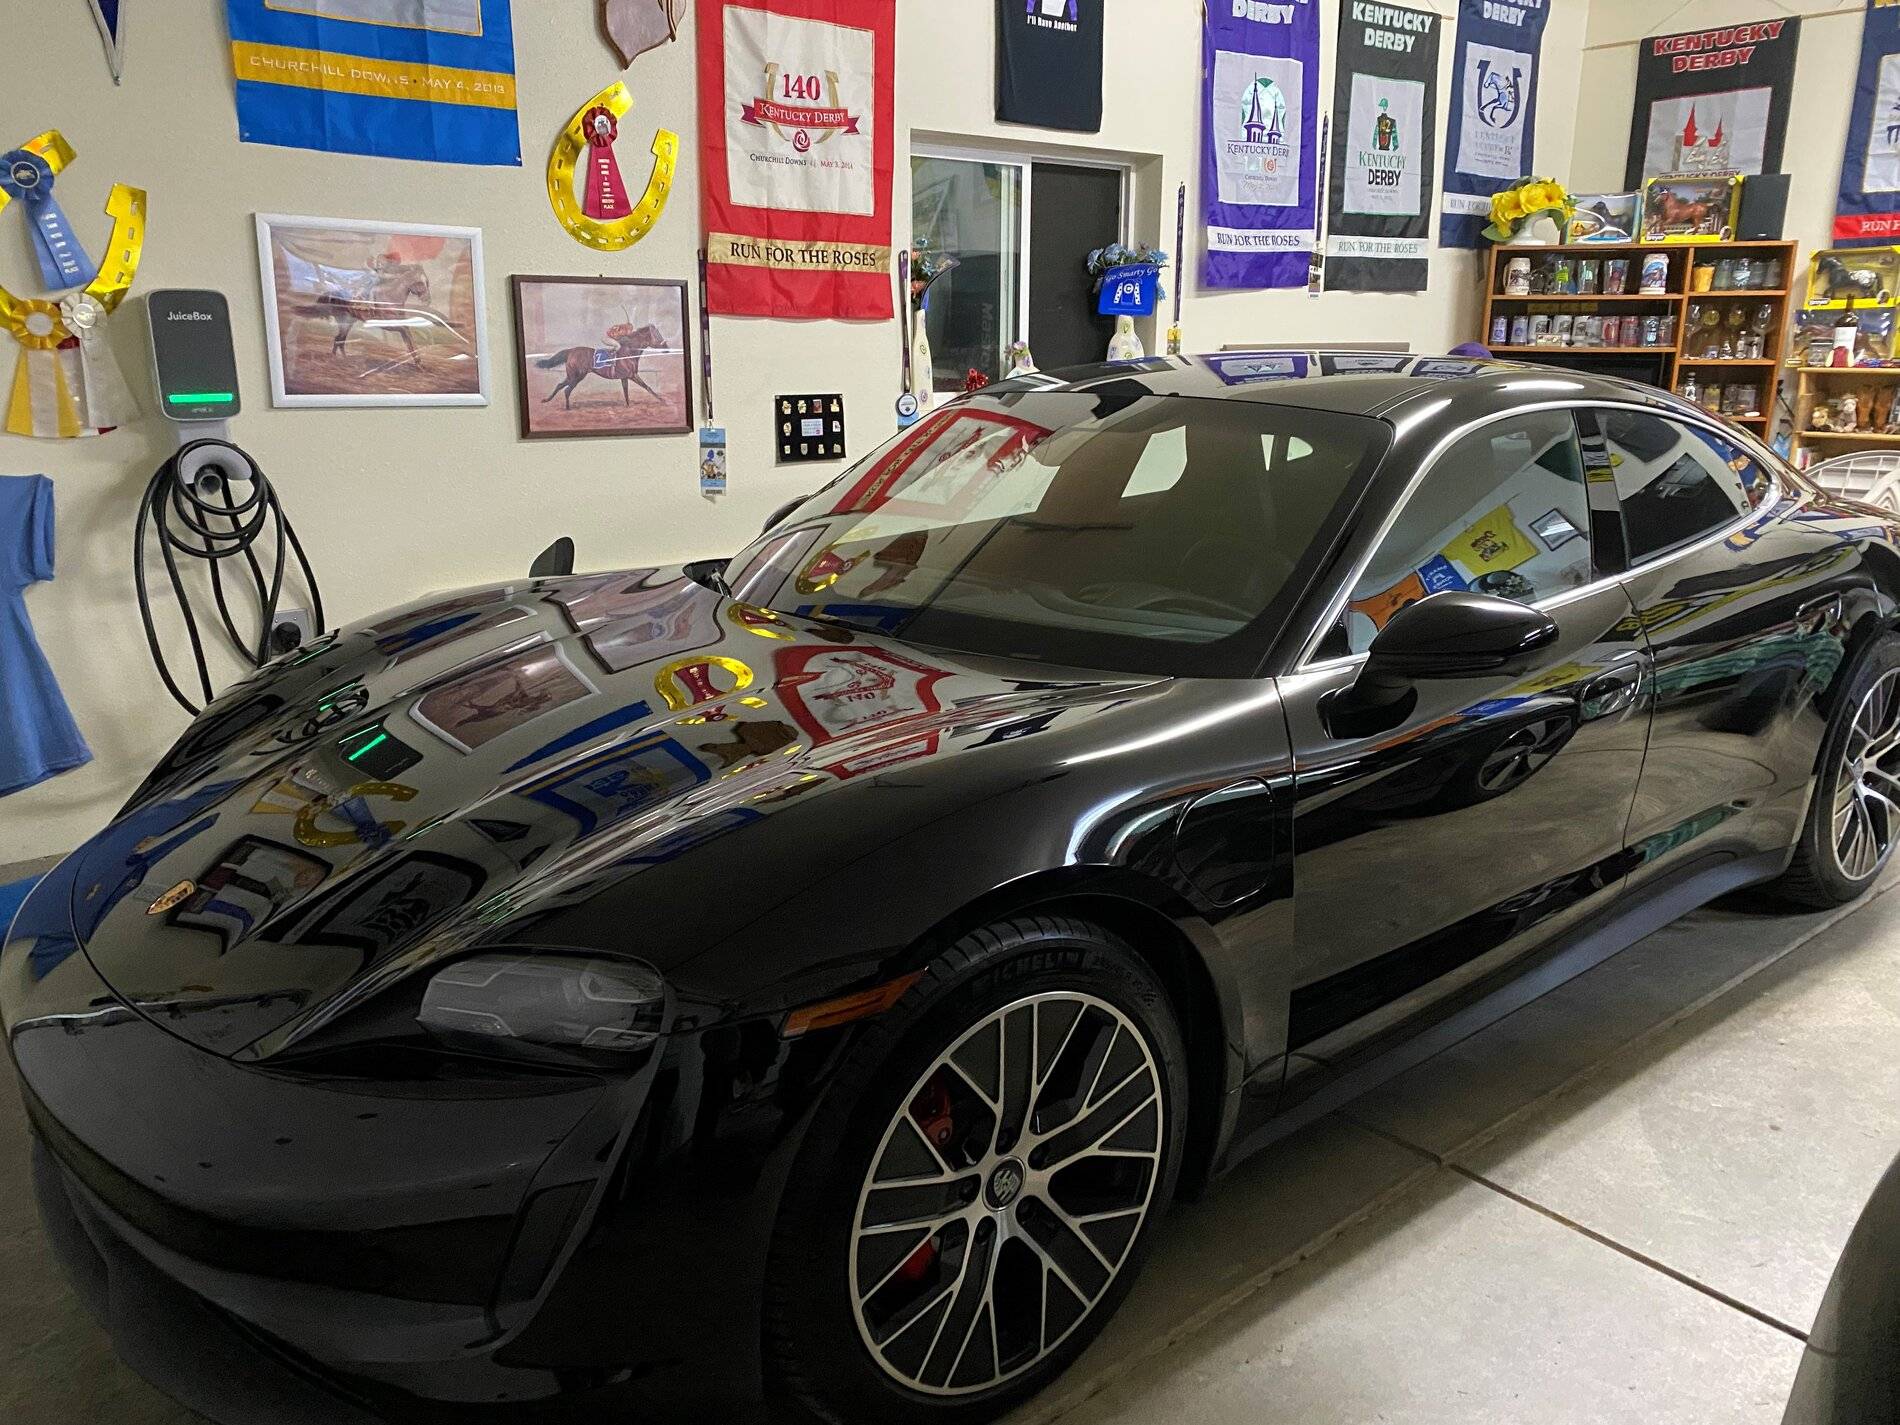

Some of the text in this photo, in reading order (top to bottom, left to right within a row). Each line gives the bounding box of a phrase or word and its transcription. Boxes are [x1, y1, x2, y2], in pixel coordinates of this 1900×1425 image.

[1027, 14, 1077, 32] I'll Have Another
[1232, 0, 1295, 24] DERBY
[1352, 1, 1433, 33] KENTUCKY
[1483, 0, 1526, 27] DERBY
[1363, 28, 1416, 53] DERBY
[1653, 20, 1786, 56] KENTUCKY
[1672, 45, 1756, 73] DERBY
[249, 55, 345, 77] CHURCHILL
[421, 76, 451, 89] MAY
[473, 81, 505, 94] 2013
[783, 73, 821, 101] 140
[759, 102, 845, 124] KENTUCKY DERBY
[749, 153, 785, 164] CHURCHILL
[785, 157, 807, 167] DOWNS
[820, 160, 833, 168] MAY
[1227, 143, 1272, 156] KENTUCKY
[1367, 168, 1401, 186] DERBY
[1861, 220, 1891, 232] RUN
[1217, 232, 1233, 245] RUN
[1252, 235, 1270, 247] THE
[1271, 235, 1300, 247] ROSES
[1338, 241, 1418, 254] RUN FOR THE ROSES
[730, 242, 876, 267] RUN FOR THE ROSES
[1116, 269, 1146, 280] Smarty
[1146, 266, 1158, 276] Go
[167, 311, 213, 321] JuiceBox
[975, 951, 1079, 988] ICHELIN
